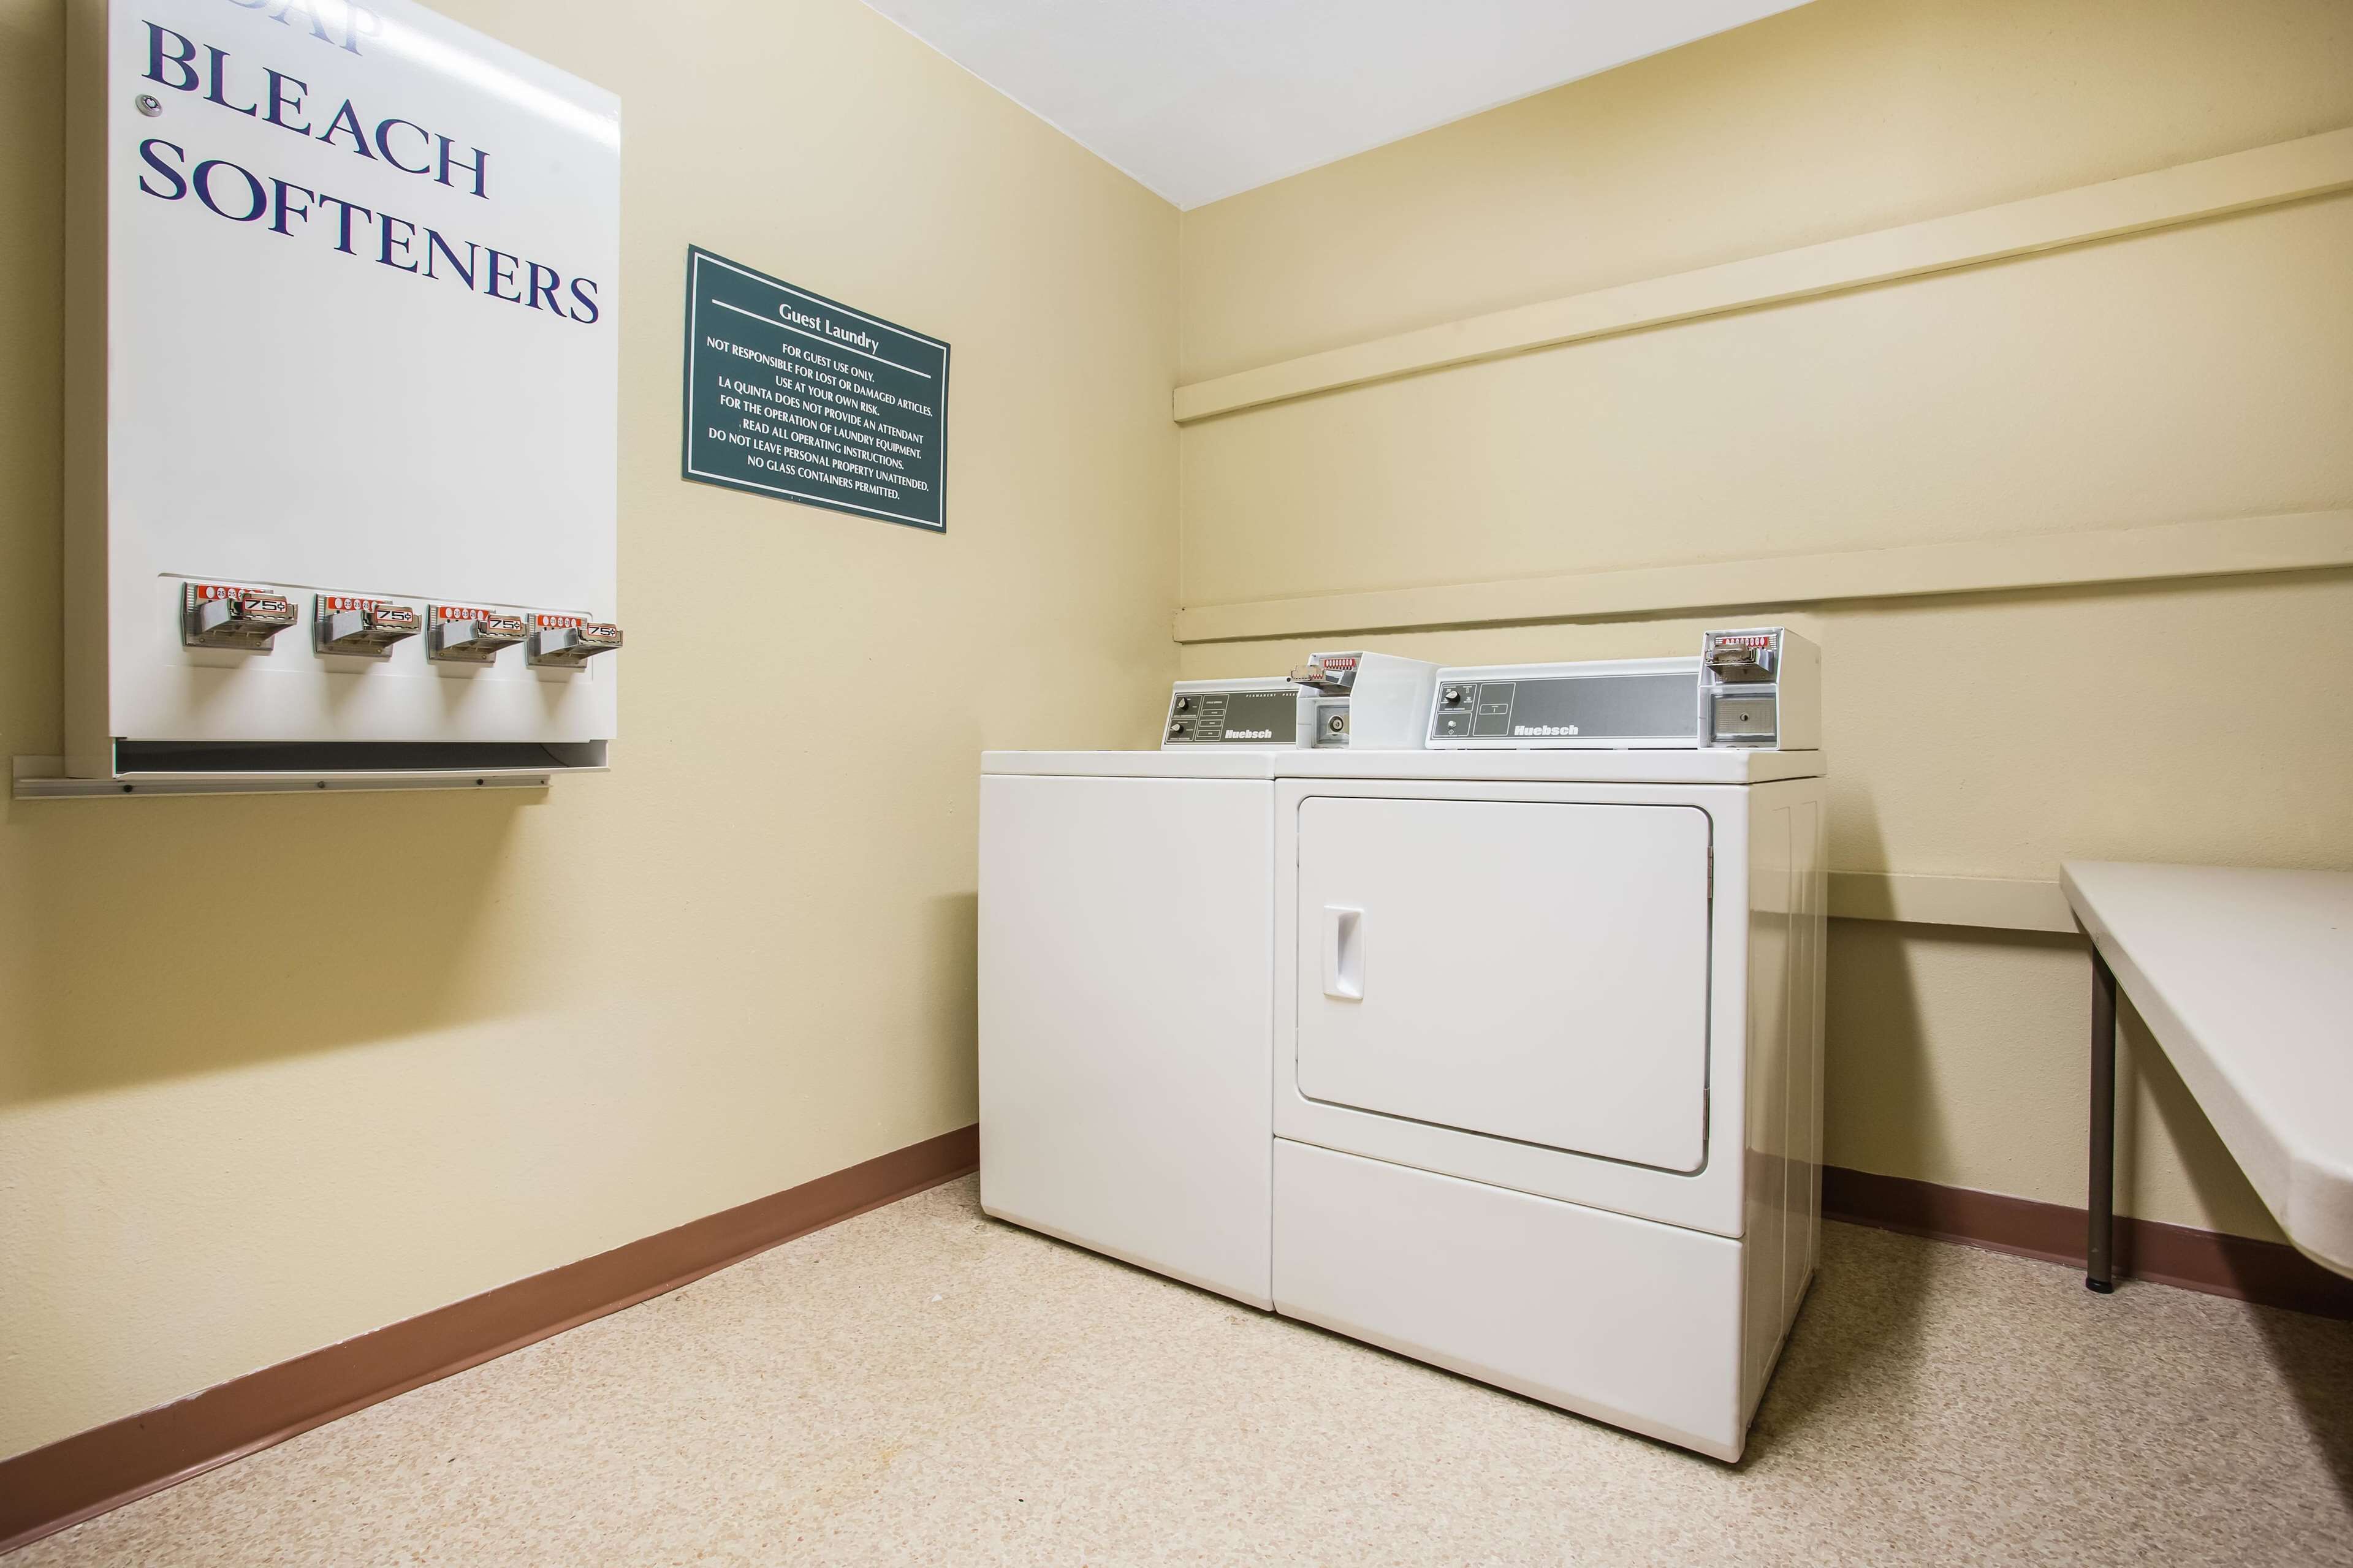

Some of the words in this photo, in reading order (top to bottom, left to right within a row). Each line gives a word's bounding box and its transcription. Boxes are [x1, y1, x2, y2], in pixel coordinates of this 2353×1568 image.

[141, 20, 490, 199] BLEACH
[139, 139, 598, 324] SOFTENERS
[779, 303, 821, 331] Guest
[825, 319, 878, 354] Laundry
[707, 336, 729, 352] NOT
[732, 344, 793, 372] RESPONSIBLE
[794, 364, 813, 379] FOR
[815, 371, 837, 385] LOST
[838, 379, 851, 391] OR
[854, 383, 895, 404] DAMAGED
[897, 398, 932, 417] ARTICLES.
[782, 343, 800, 358] FOR
[803, 350, 831, 368] GUEST
[833, 360, 848, 374] USE
[850, 366, 874, 382] ONLY.
[718, 376, 731, 388] LA
[734, 381, 772, 400] QUINTA
[775, 392, 800, 408] DOES
[802, 400, 822, 414] NOT
[824, 406, 861, 426] PROVIDE
[863, 419, 875, 430] AN
[877, 423, 923, 444] ATTENDANT
[775, 375, 792, 389] USE
[794, 382, 805, 393] AT
[808, 385, 833, 401] YOUR
[835, 394, 857, 409] OWN
[860, 401, 880, 415] RISK.
[720, 394, 740, 409] FOR
[743, 400, 761, 415] THE
[764, 407, 817, 430] OPERATION
[819, 422, 832, 433] OF
[834, 426, 874, 445] LAUNDRY
[876, 437, 921, 458] EQUIPMENT.
[743, 418, 769, 433] READ
[772, 426, 788, 439] ALL
[791, 431, 841, 453] OPERATING
[843, 445, 903, 469] INSTRUCTIONS.
[709, 427, 726, 441] DO
[729, 432, 751, 447] NOT
[753, 439, 781, 455] LEAVE
[783, 446, 830, 466] PERSONAL
[832, 458, 873, 477] PROPERTY
[875, 469, 929, 491] UNATTENDED.
[747, 455, 764, 468] NO
[766, 460, 795, 475] GLASS
[797, 467, 853, 488] CONTAINERS
[854, 480, 899, 499] PERMITTED.
[245, 599, 285, 612] 75¢
[377, 610, 411, 621] 75¢
[490, 619, 520, 629] 75¢
[589, 626, 615, 636] 75¢
[1225, 729, 1272, 738] Huebsch
[1515, 725, 1579, 735] Huebsch
